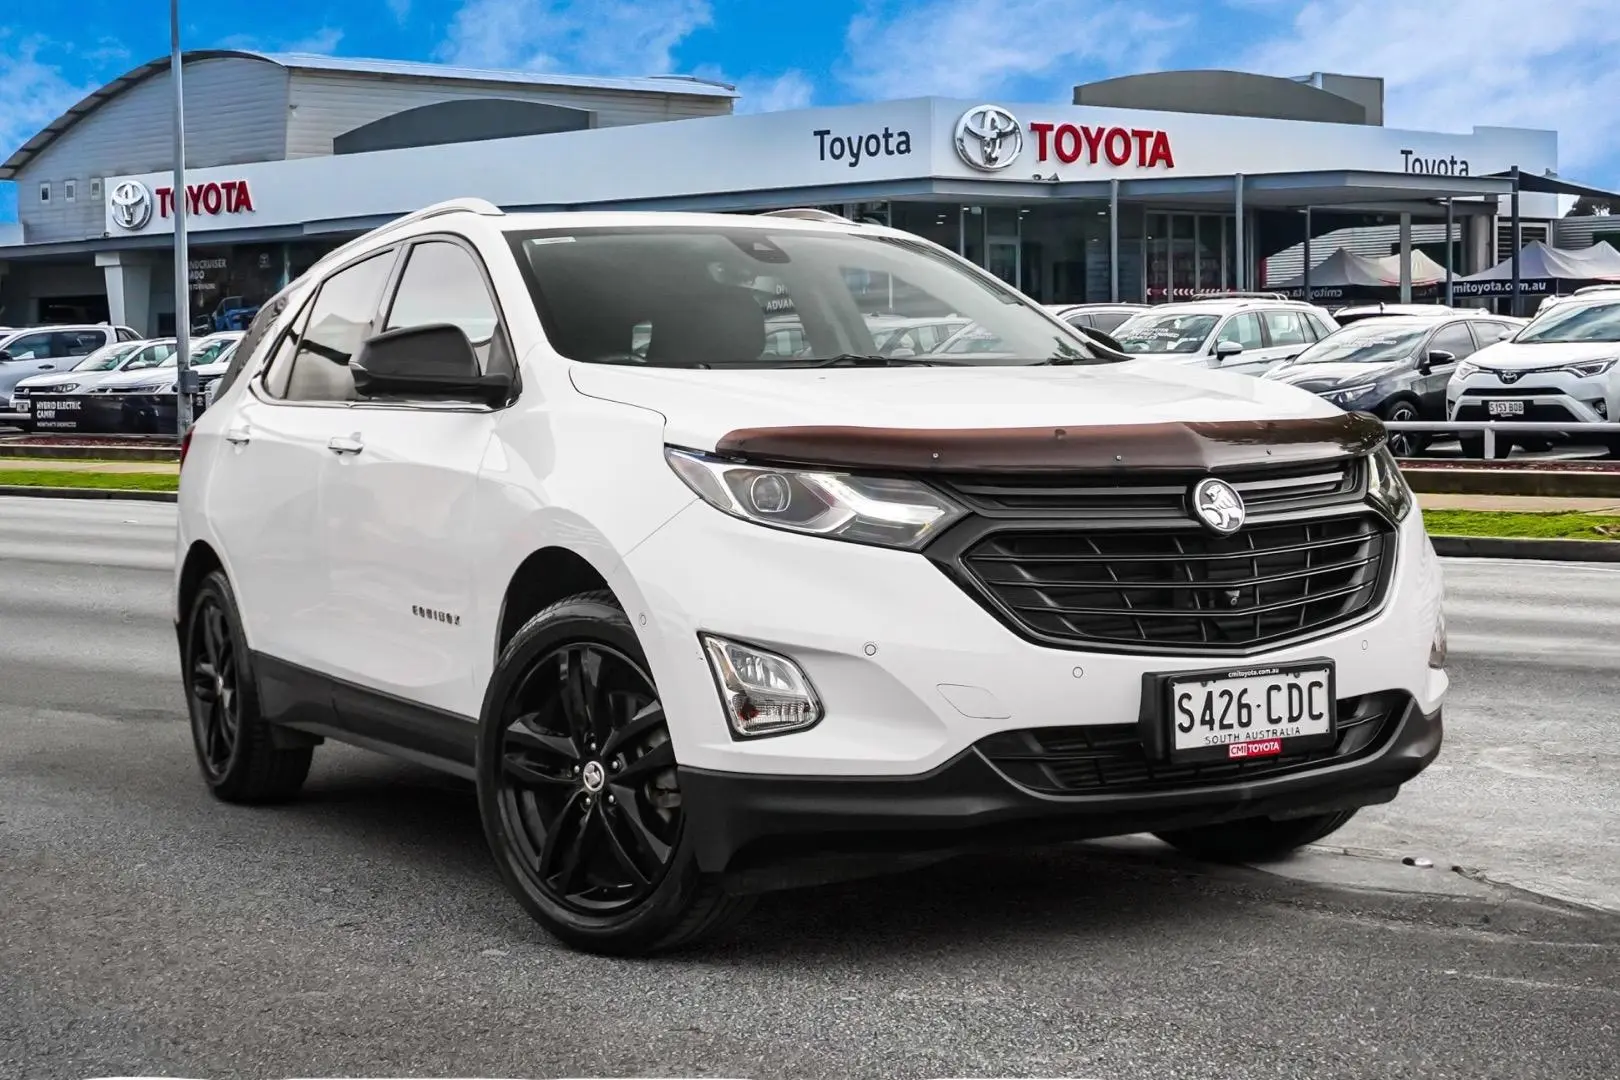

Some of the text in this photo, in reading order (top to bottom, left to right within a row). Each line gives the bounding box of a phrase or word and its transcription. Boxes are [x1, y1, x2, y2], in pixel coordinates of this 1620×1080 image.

[813, 127, 912, 167] Toyota
[1030, 122, 1174, 168] TOYOTA
[1453, 281, 1547, 294] mitoyota.cm.au
[1228, 668, 1280, 678] cmitoyota.com.au
[1205, 726, 1301, 745] SOUTH AUSTRALIA
[1230, 742, 1280, 756] CMI TOYOTA
